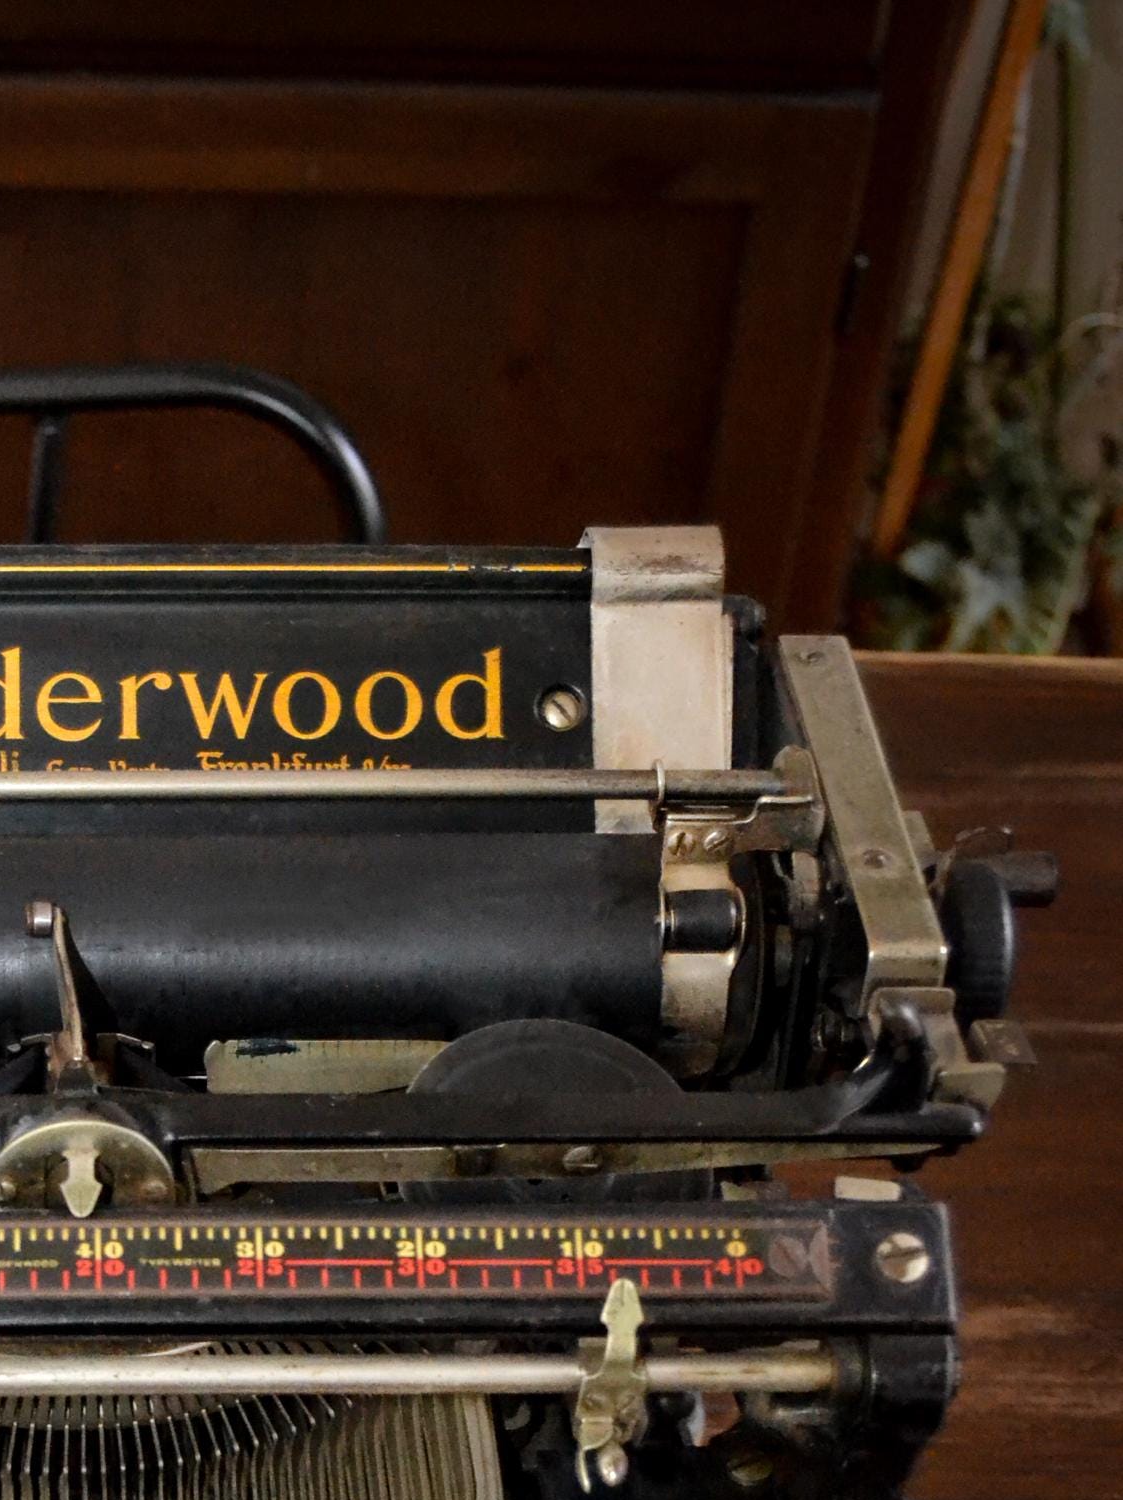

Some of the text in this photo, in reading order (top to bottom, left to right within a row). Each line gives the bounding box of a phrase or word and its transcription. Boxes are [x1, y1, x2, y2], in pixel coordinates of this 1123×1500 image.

[75, 1241, 125, 1259] 40
[235, 1240, 285, 1259] 30
[395, 1240, 446, 1258] 20
[558, 1240, 604, 1258] 10
[726, 1240, 747, 1258] 0
[75, 1258, 125, 1277] 20
[236, 1258, 285, 1276] 25
[396, 1258, 446, 1276] 30
[556, 1258, 604, 1276] 35
[715, 1257, 764, 1276] 40
[139, 1257, 222, 1267] TYPEWRITER
